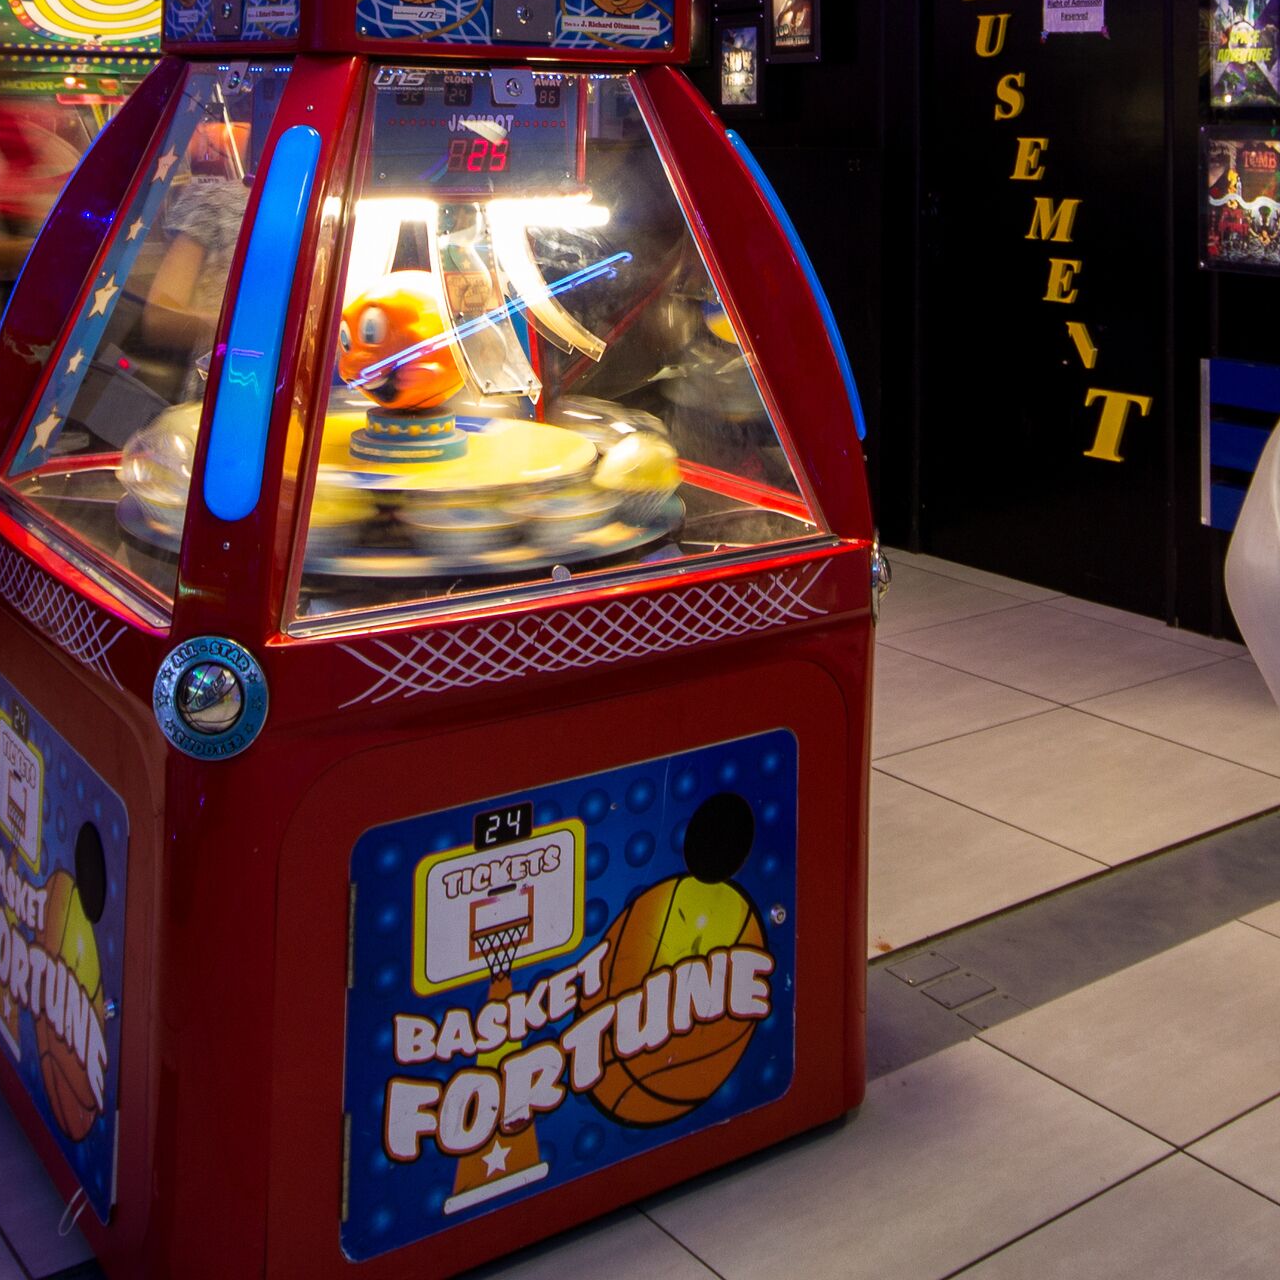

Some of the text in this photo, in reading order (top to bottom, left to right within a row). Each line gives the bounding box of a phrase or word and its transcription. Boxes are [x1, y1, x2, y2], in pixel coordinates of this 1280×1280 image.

[1047, 0, 1062, 8] Right
[1071, 0, 1102, 7] Admission
[588, 21, 613, 29] Richard
[1230, 30, 1260, 45] SPACE
[1217, 47, 1273, 63] ADVENTURE
[374, 72, 427, 86] UNIS
[444, 75, 474, 84] CLOCK
[534, 77, 562, 87] AWAY
[448, 88, 467, 103] 24
[1243, 151, 1277, 169] TOMB
[172, 730, 246, 756] SHOOTER
[1, 730, 37, 790] TICKETS
[484, 809, 521, 844] 24
[442, 844, 561, 899] TICKETS
[393, 941, 611, 1065] BASKET
[384, 945, 776, 1162] FORTUNE
